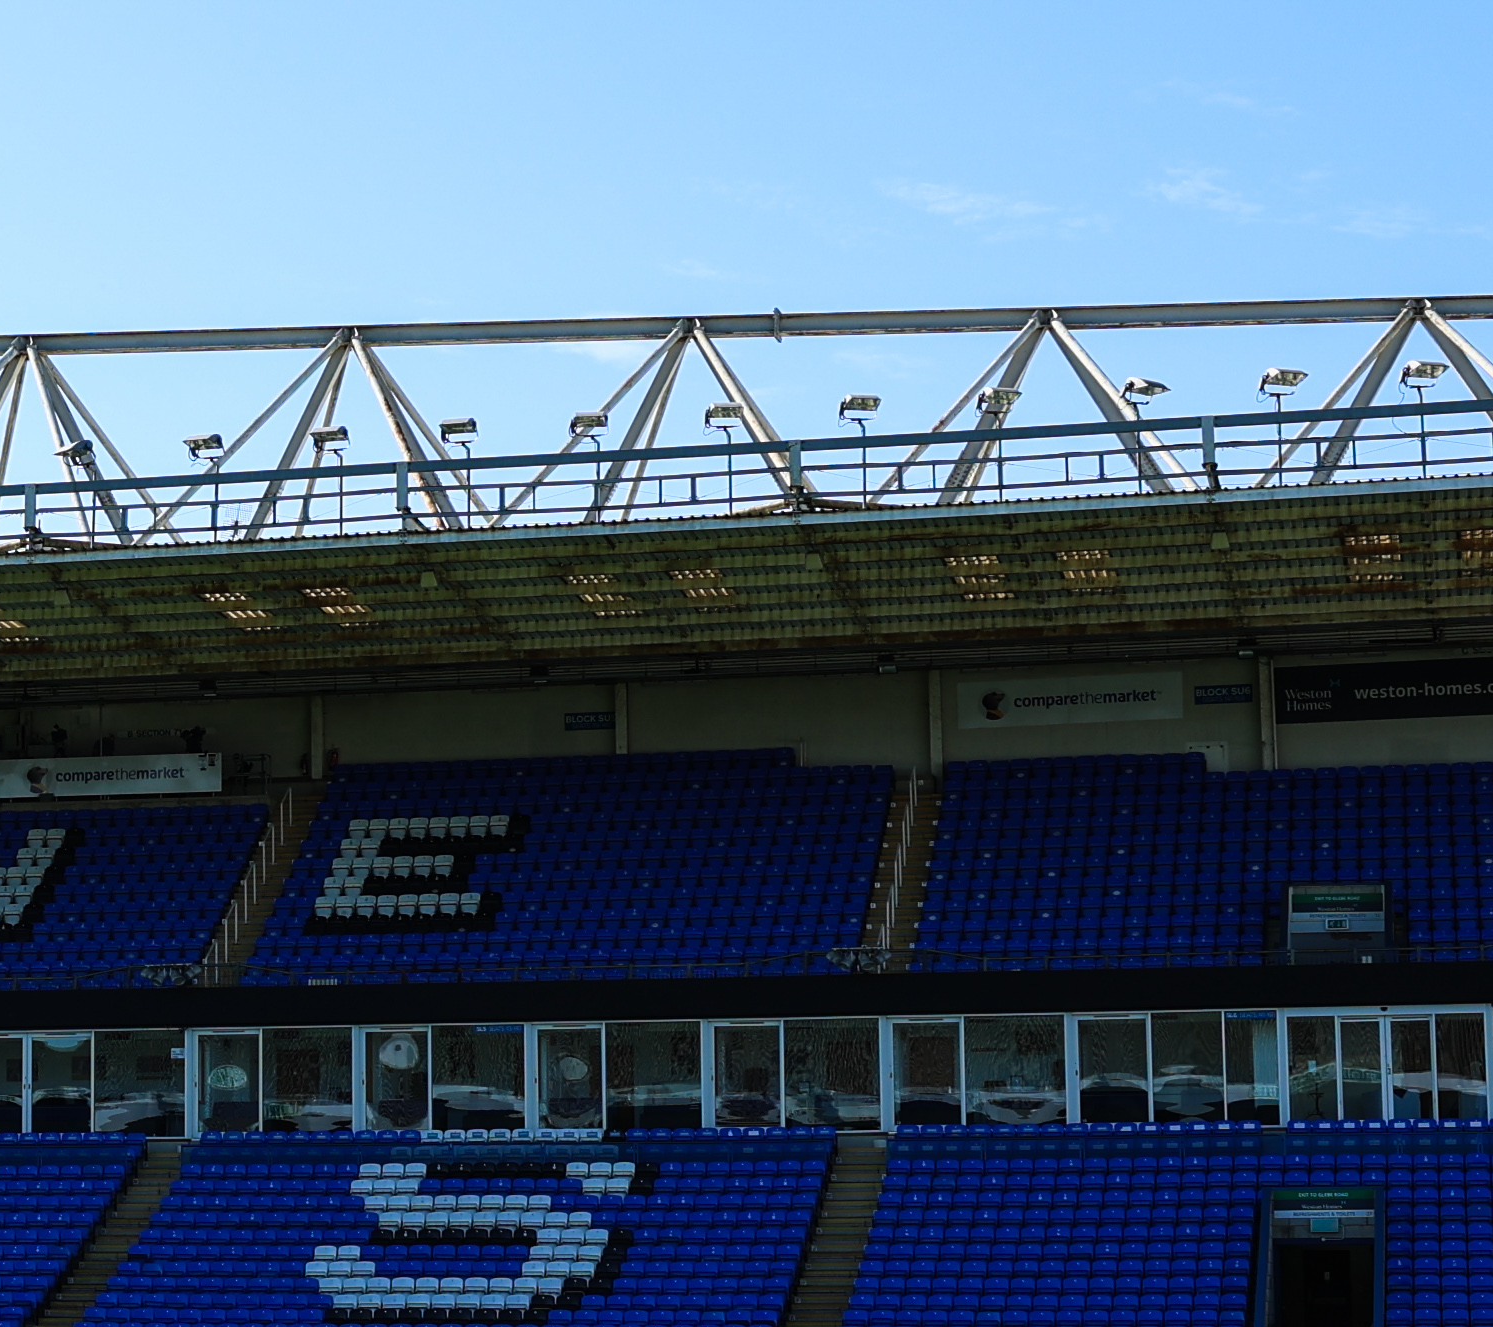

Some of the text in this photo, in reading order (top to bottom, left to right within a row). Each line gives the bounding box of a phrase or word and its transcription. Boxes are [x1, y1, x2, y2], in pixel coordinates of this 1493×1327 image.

[1196, 686, 1251, 697] BLOCK SU6
[1284, 688, 1332, 700] Weston
[1014, 689, 1157, 709] comparethemarket
[1286, 699, 1332, 712] Homes
[566, 715, 596, 723] BLOCK
[136, 729, 171, 737] SECTION
[56, 766, 185, 784] comparethemarket
